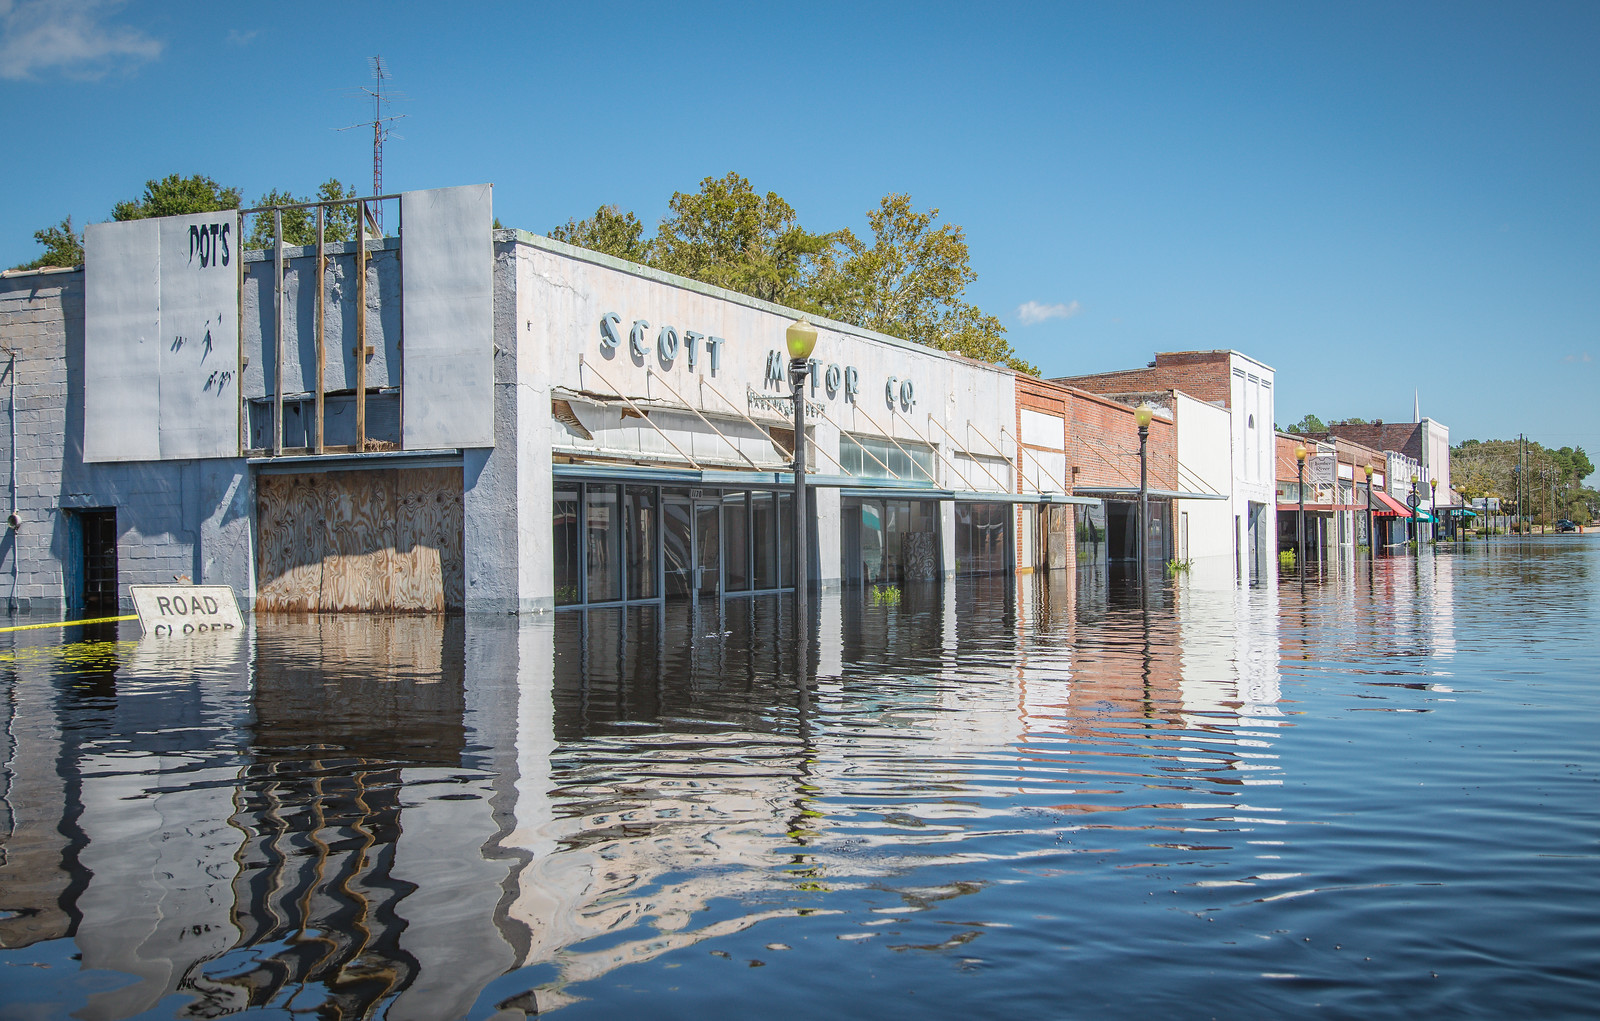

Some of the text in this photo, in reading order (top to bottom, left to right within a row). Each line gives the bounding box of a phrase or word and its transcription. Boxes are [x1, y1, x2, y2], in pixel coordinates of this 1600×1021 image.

[189, 223, 230, 268] DOT'S
[600, 312, 725, 370] SCOTT
[766, 349, 860, 395] MTOR
[157, 595, 218, 615] ROAD
